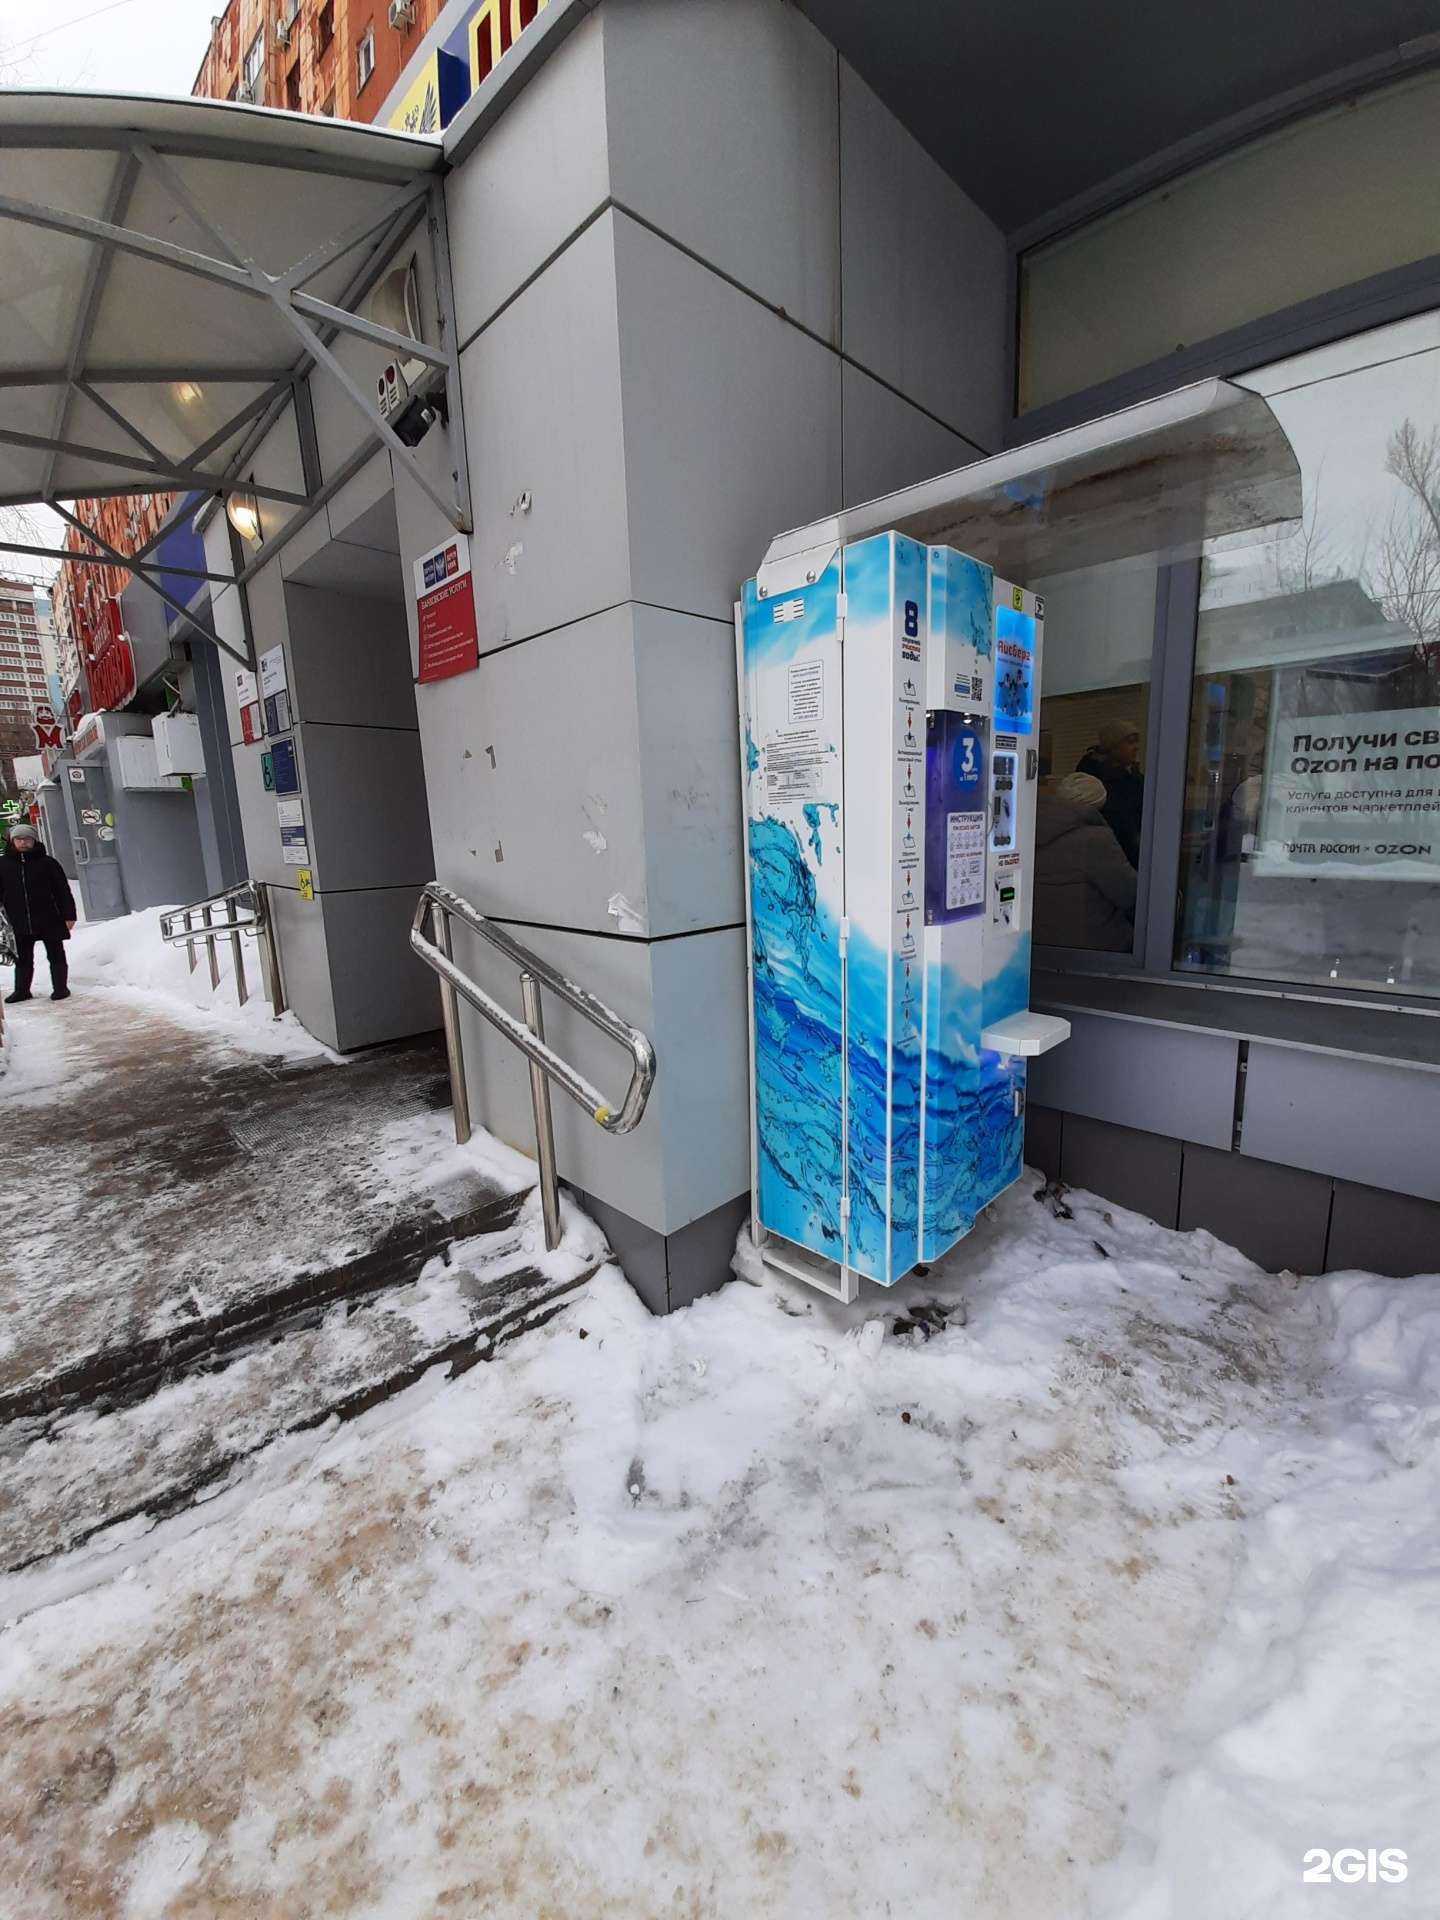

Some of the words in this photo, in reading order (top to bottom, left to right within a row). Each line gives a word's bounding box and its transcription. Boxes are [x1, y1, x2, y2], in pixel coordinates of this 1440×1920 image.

[904, 599, 919, 638] 8
[1292, 732, 1398, 754] Получи
[961, 737, 975, 773] 3
[1290, 756, 1357, 775] Ozon
[1364, 756, 1399, 772] на
[1287, 791, 1331, 801] Услуга
[1334, 789, 1401, 801] доступна
[1405, 788, 1433, 798] для
[1286, 804, 1349, 814] клиентов
[1320, 843, 1360, 854] РОССИИ
[1374, 844, 1432, 855] OZON
